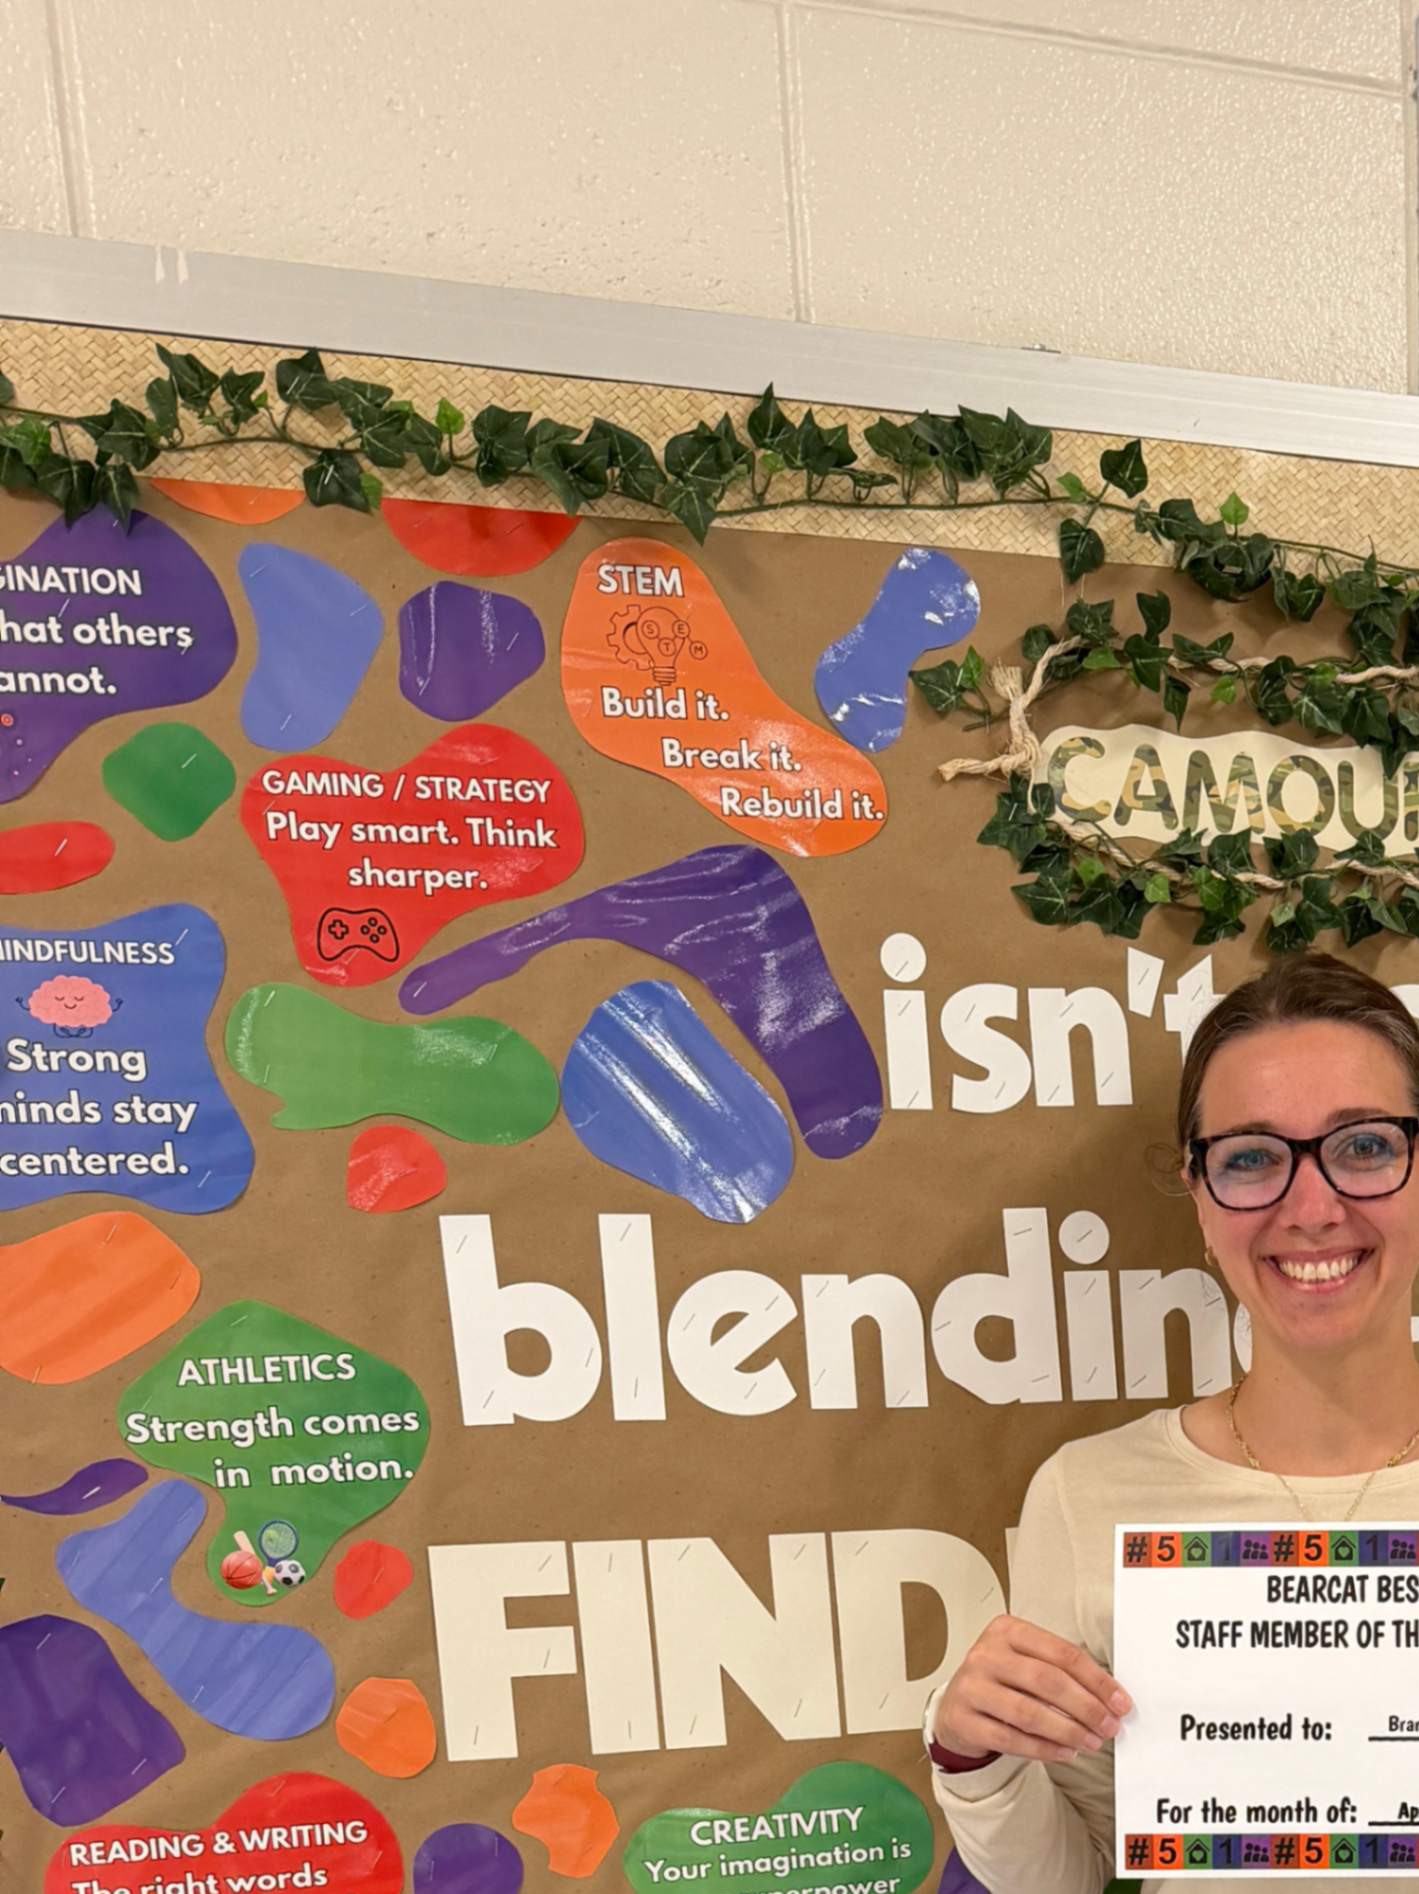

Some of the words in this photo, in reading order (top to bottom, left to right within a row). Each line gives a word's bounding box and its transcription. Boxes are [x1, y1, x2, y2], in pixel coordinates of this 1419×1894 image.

[0, 565, 142, 596] INATION
[598, 563, 685, 598] STEM
[0, 609, 64, 644] hat
[72, 612, 193, 648] others
[0, 666, 117, 695] annot.
[601, 686, 687, 720] Build
[696, 690, 730, 721] it.
[661, 736, 764, 771] Break
[770, 742, 802, 772] it.
[262, 770, 384, 798] GAMING
[415, 775, 551, 803] STRATEGY
[720, 786, 843, 819] Rebuild
[851, 790, 885, 821] it.
[266, 810, 341, 850] Play
[351, 820, 460, 846] smart.
[465, 817, 558, 848] Think
[349, 857, 488, 896] sharper.
[0, 939, 175, 965] INDFULNESS
[6, 1037, 147, 1082] Strong
[114, 1095, 198, 1133] stay
[1, 1141, 190, 1176] centered.
[439, 1207, 1252, 1426] blendin
[177, 1352, 356, 1387] ATHLETICS
[126, 1405, 293, 1448] Strength
[303, 1410, 420, 1436] comes
[213, 1458, 250, 1489] in
[270, 1451, 414, 1486] motion.
[1267, 1575, 1369, 1603] BEARCAT
[427, 1527, 1018, 1761] FIND
[1176, 1620, 1243, 1649] STAFF
[1250, 1620, 1349, 1649] MEMBER
[1357, 1620, 1385, 1648] OF
[1180, 1713, 1292, 1741] Presented
[1302, 1717, 1332, 1741] to:
[690, 1806, 865, 1846] CREATIVITY
[1157, 1798, 1192, 1823] For
[1201, 1797, 1237, 1823] the
[1247, 1796, 1318, 1823] month
[1327, 1796, 1357, 1823] of:
[70, 1834, 205, 1866] READING
[213, 1831, 236, 1855] &
[239, 1820, 368, 1852] WRITING
[644, 1859, 712, 1883] Your
[719, 1842, 885, 1878] imagination
[891, 1837, 913, 1859] is
[226, 1862, 328, 1892] words
